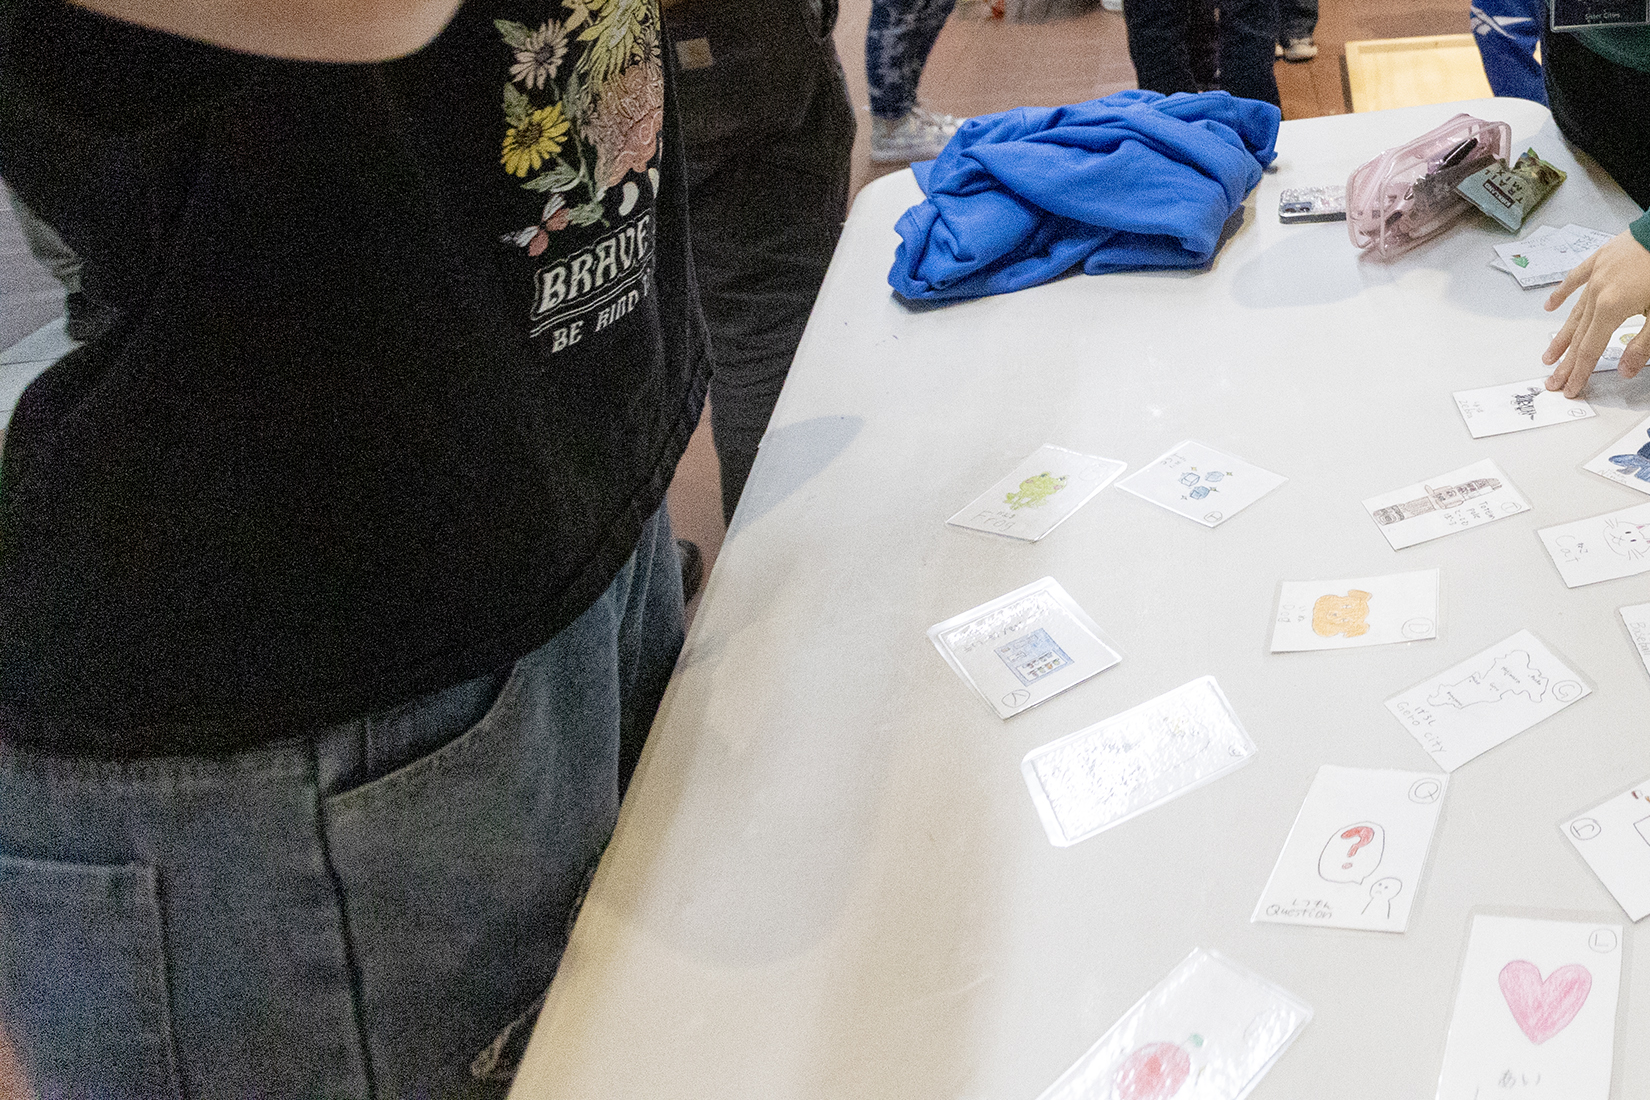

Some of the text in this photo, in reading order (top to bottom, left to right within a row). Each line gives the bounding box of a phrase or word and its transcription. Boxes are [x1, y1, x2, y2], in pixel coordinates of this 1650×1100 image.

[541, 215, 650, 312] BRAVE
[551, 318, 583, 354] BE
[969, 510, 1016, 532] Frog
